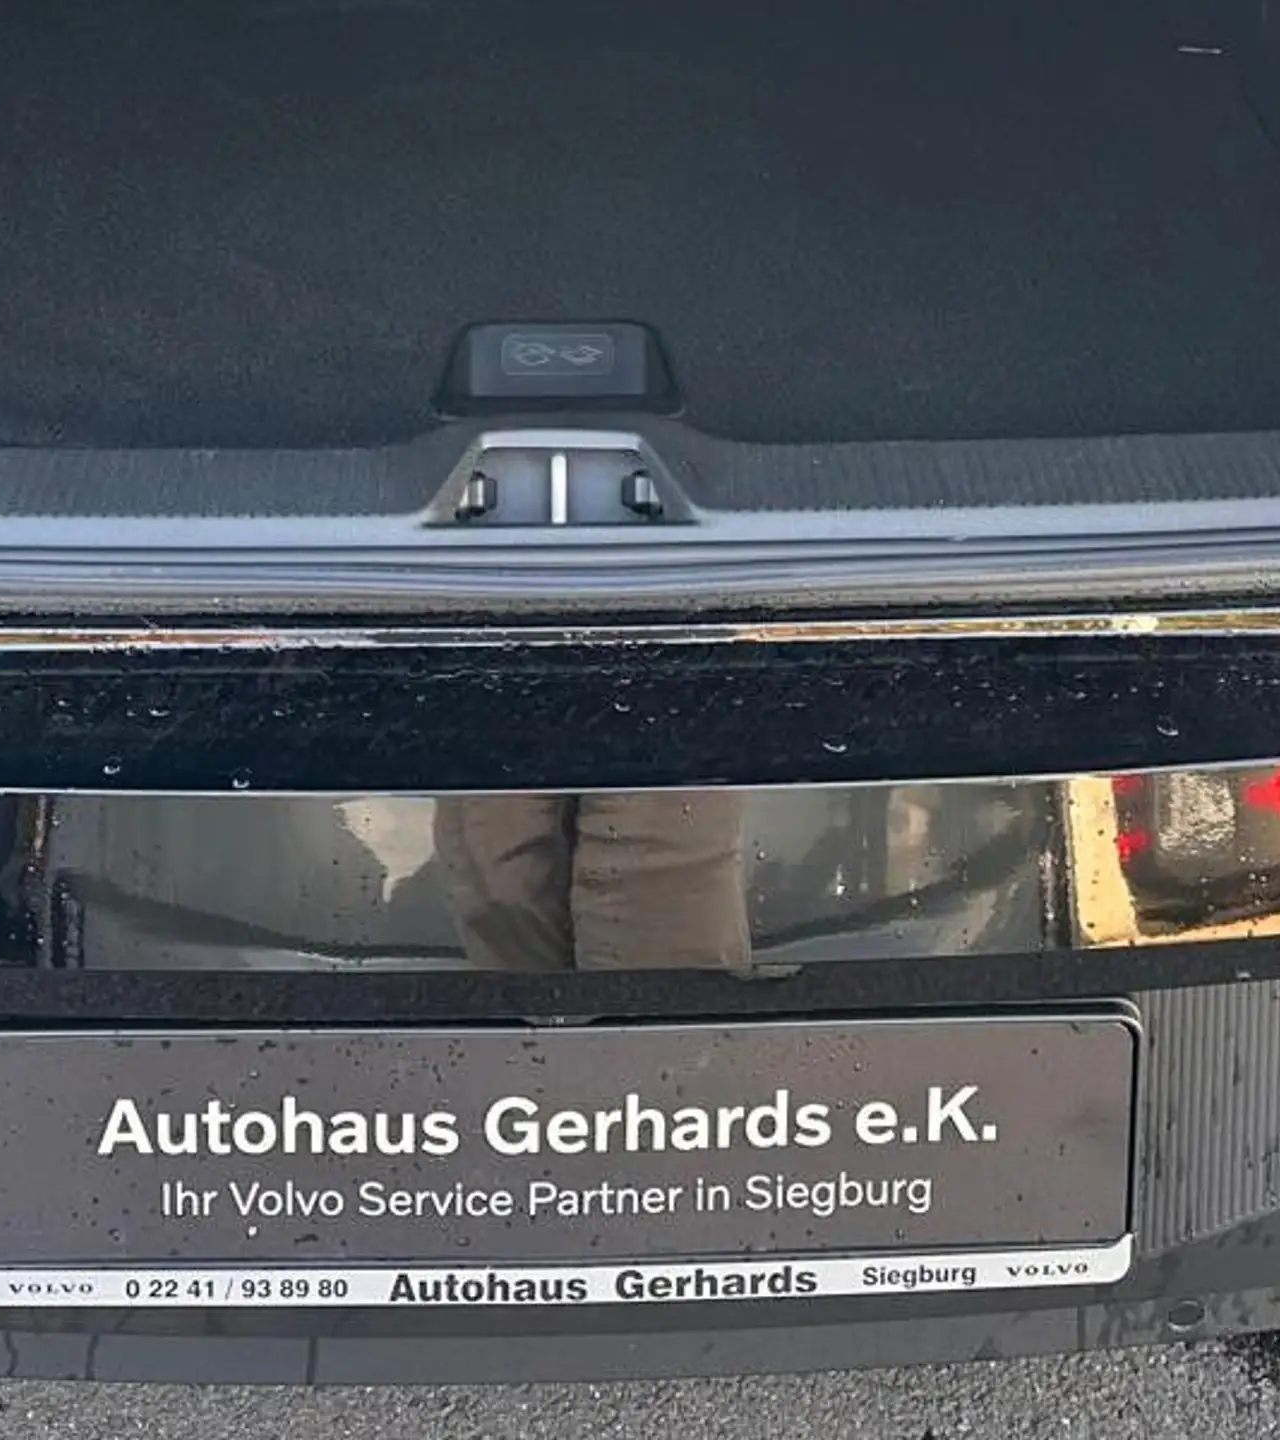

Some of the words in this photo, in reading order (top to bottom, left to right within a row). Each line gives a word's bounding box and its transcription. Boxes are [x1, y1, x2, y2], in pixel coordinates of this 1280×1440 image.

[97, 1096, 460, 1156] Autohaus
[484, 1090, 833, 1154] Gerhards
[855, 1085, 998, 1145] e.K.
[162, 1181, 219, 1217] Ihr
[228, 1179, 345, 1217] Volvo
[358, 1179, 514, 1217] Service
[528, 1180, 684, 1217] Partner
[696, 1177, 731, 1212] in
[744, 1172, 933, 1215] Siegburg
[8, 1283, 94, 1295] VOLVO
[125, 1279, 140, 1299] 0
[148, 1279, 179, 1299] 22
[186, 1279, 215, 1299] 41
[223, 1278, 234, 1300] /
[241, 1279, 272, 1299] 93
[279, 1279, 310, 1299] 89
[318, 1279, 349, 1299] 80
[389, 1272, 589, 1302] Autohaus
[615, 1266, 819, 1300] Gerhards
[862, 1265, 978, 1289] Siegburg
[1006, 1262, 1090, 1277] VOLVO
